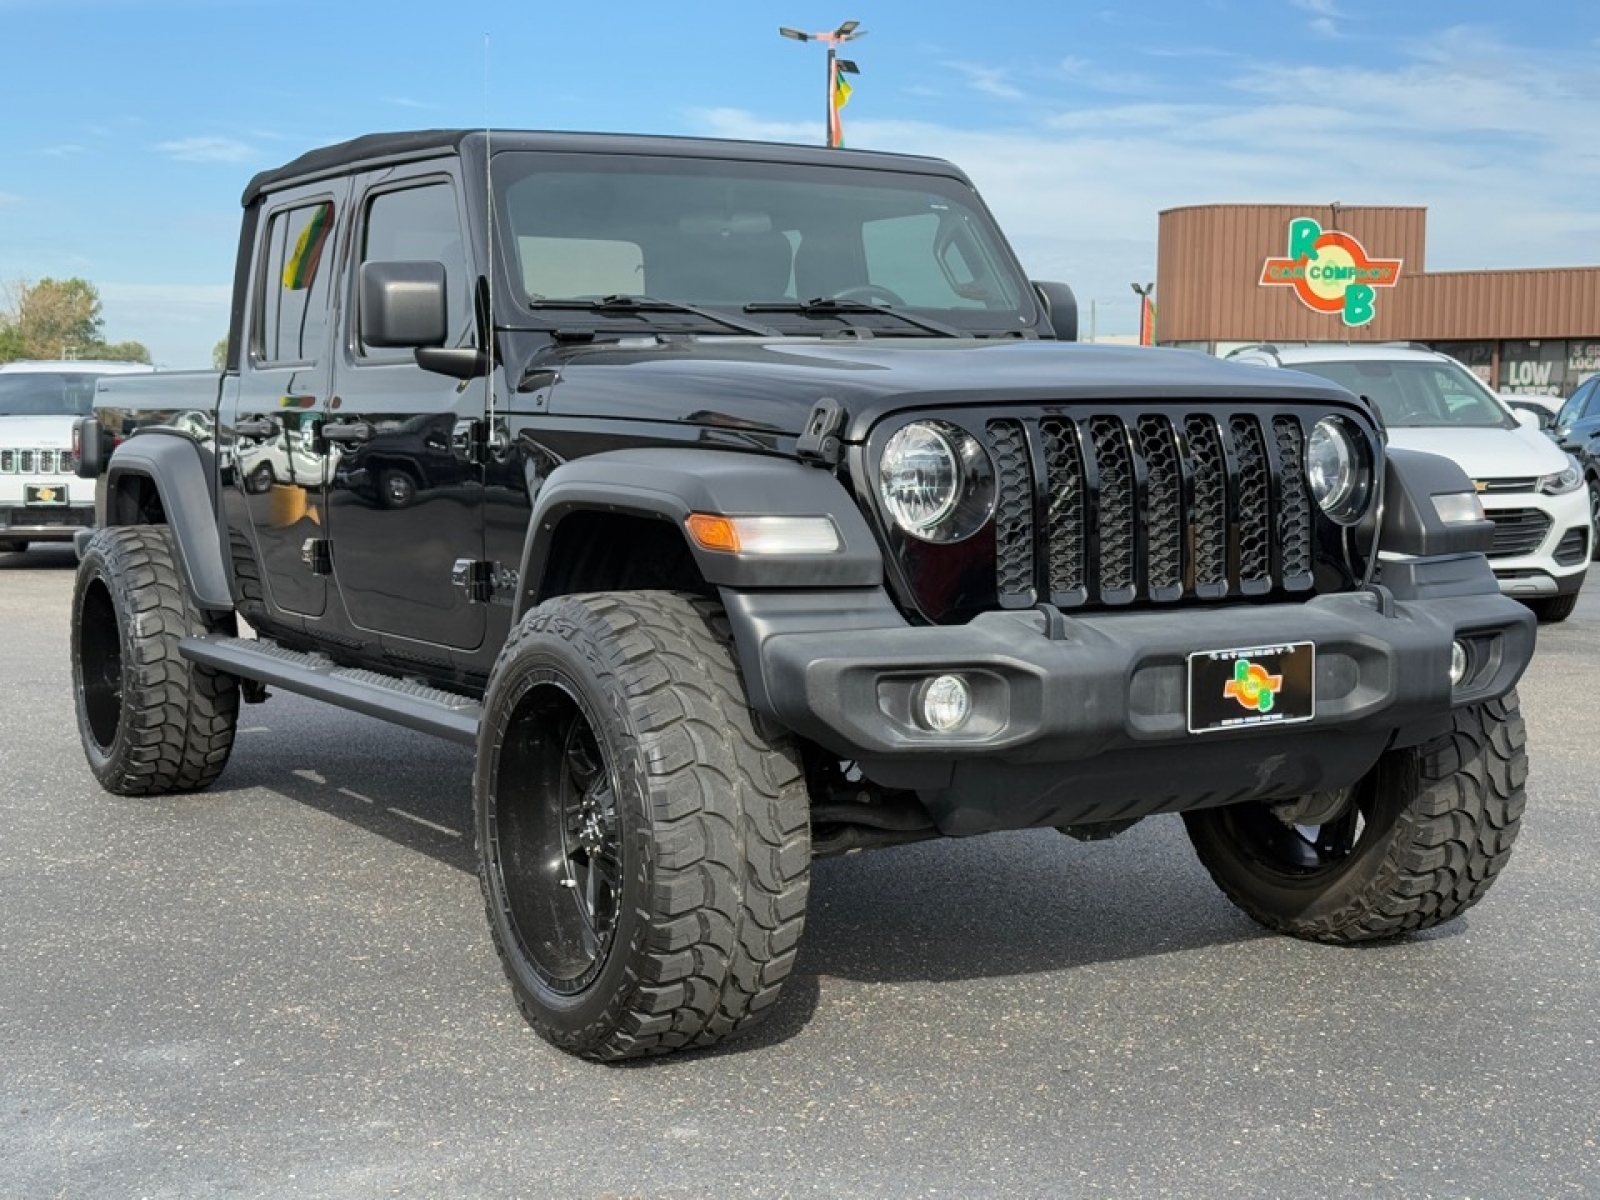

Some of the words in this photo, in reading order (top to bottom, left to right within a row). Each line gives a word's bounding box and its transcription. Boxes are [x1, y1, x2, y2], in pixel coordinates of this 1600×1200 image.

[1290, 218, 1322, 261] R
[1269, 265, 1306, 280] CAR
[1309, 265, 1393, 280] COMPANY
[1342, 283, 1375, 326] B
[1508, 361, 1553, 386] LOW
[490, 561, 520, 588] Jee
